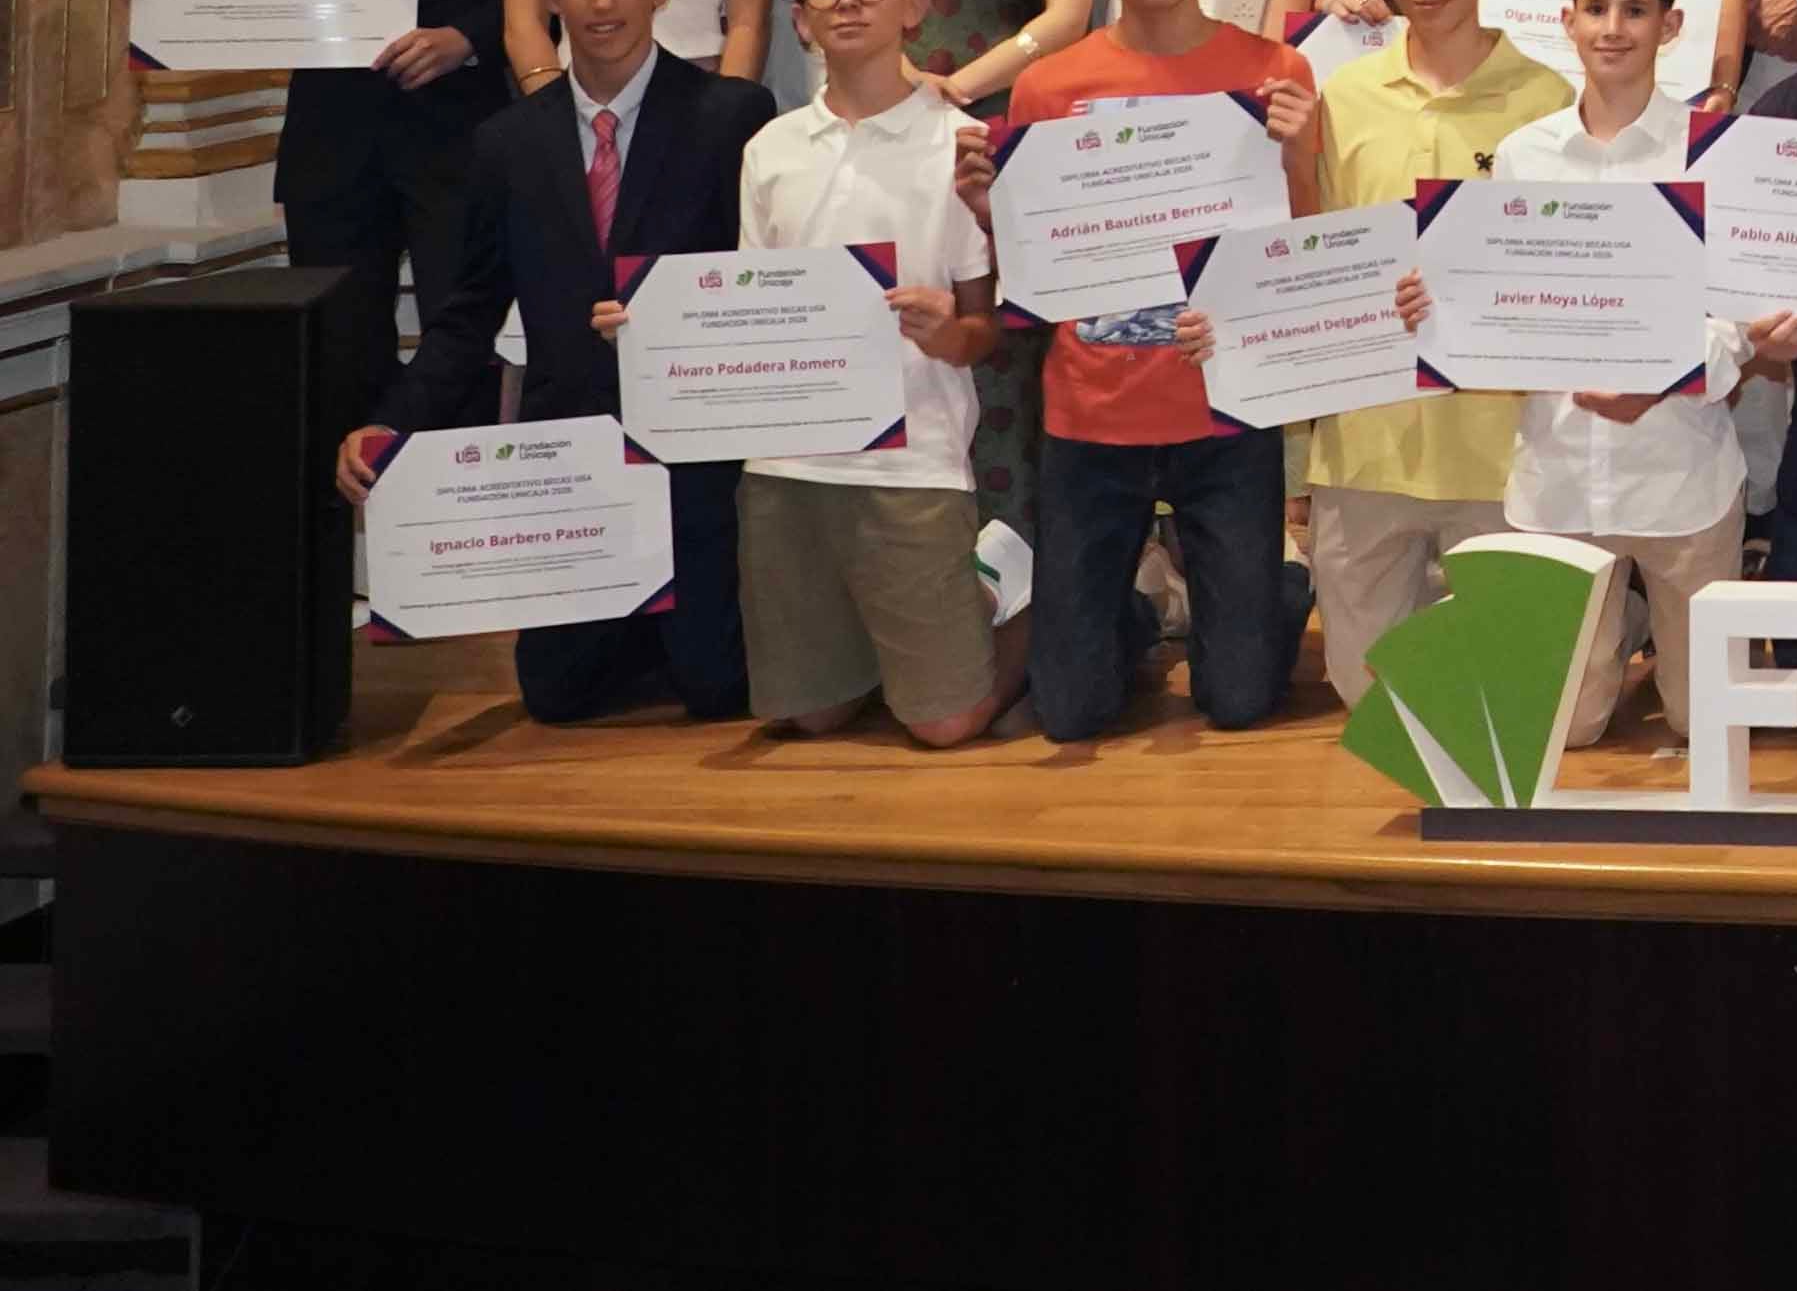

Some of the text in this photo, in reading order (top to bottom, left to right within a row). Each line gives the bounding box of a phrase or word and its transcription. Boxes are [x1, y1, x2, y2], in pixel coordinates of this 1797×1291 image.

[1050, 198, 1233, 240] Adrián Bautista Berrocal
[1730, 226, 1771, 242] Pablo
[1493, 291, 1624, 309] Javier Moya López
[1241, 332, 1268, 347] José
[1272, 321, 1321, 339] Manuel
[1325, 313, 1377, 331] Delgado
[668, 357, 846, 378] Álvaro Podadera Romero
[430, 525, 606, 553] Ignacio Barbero Pastor
